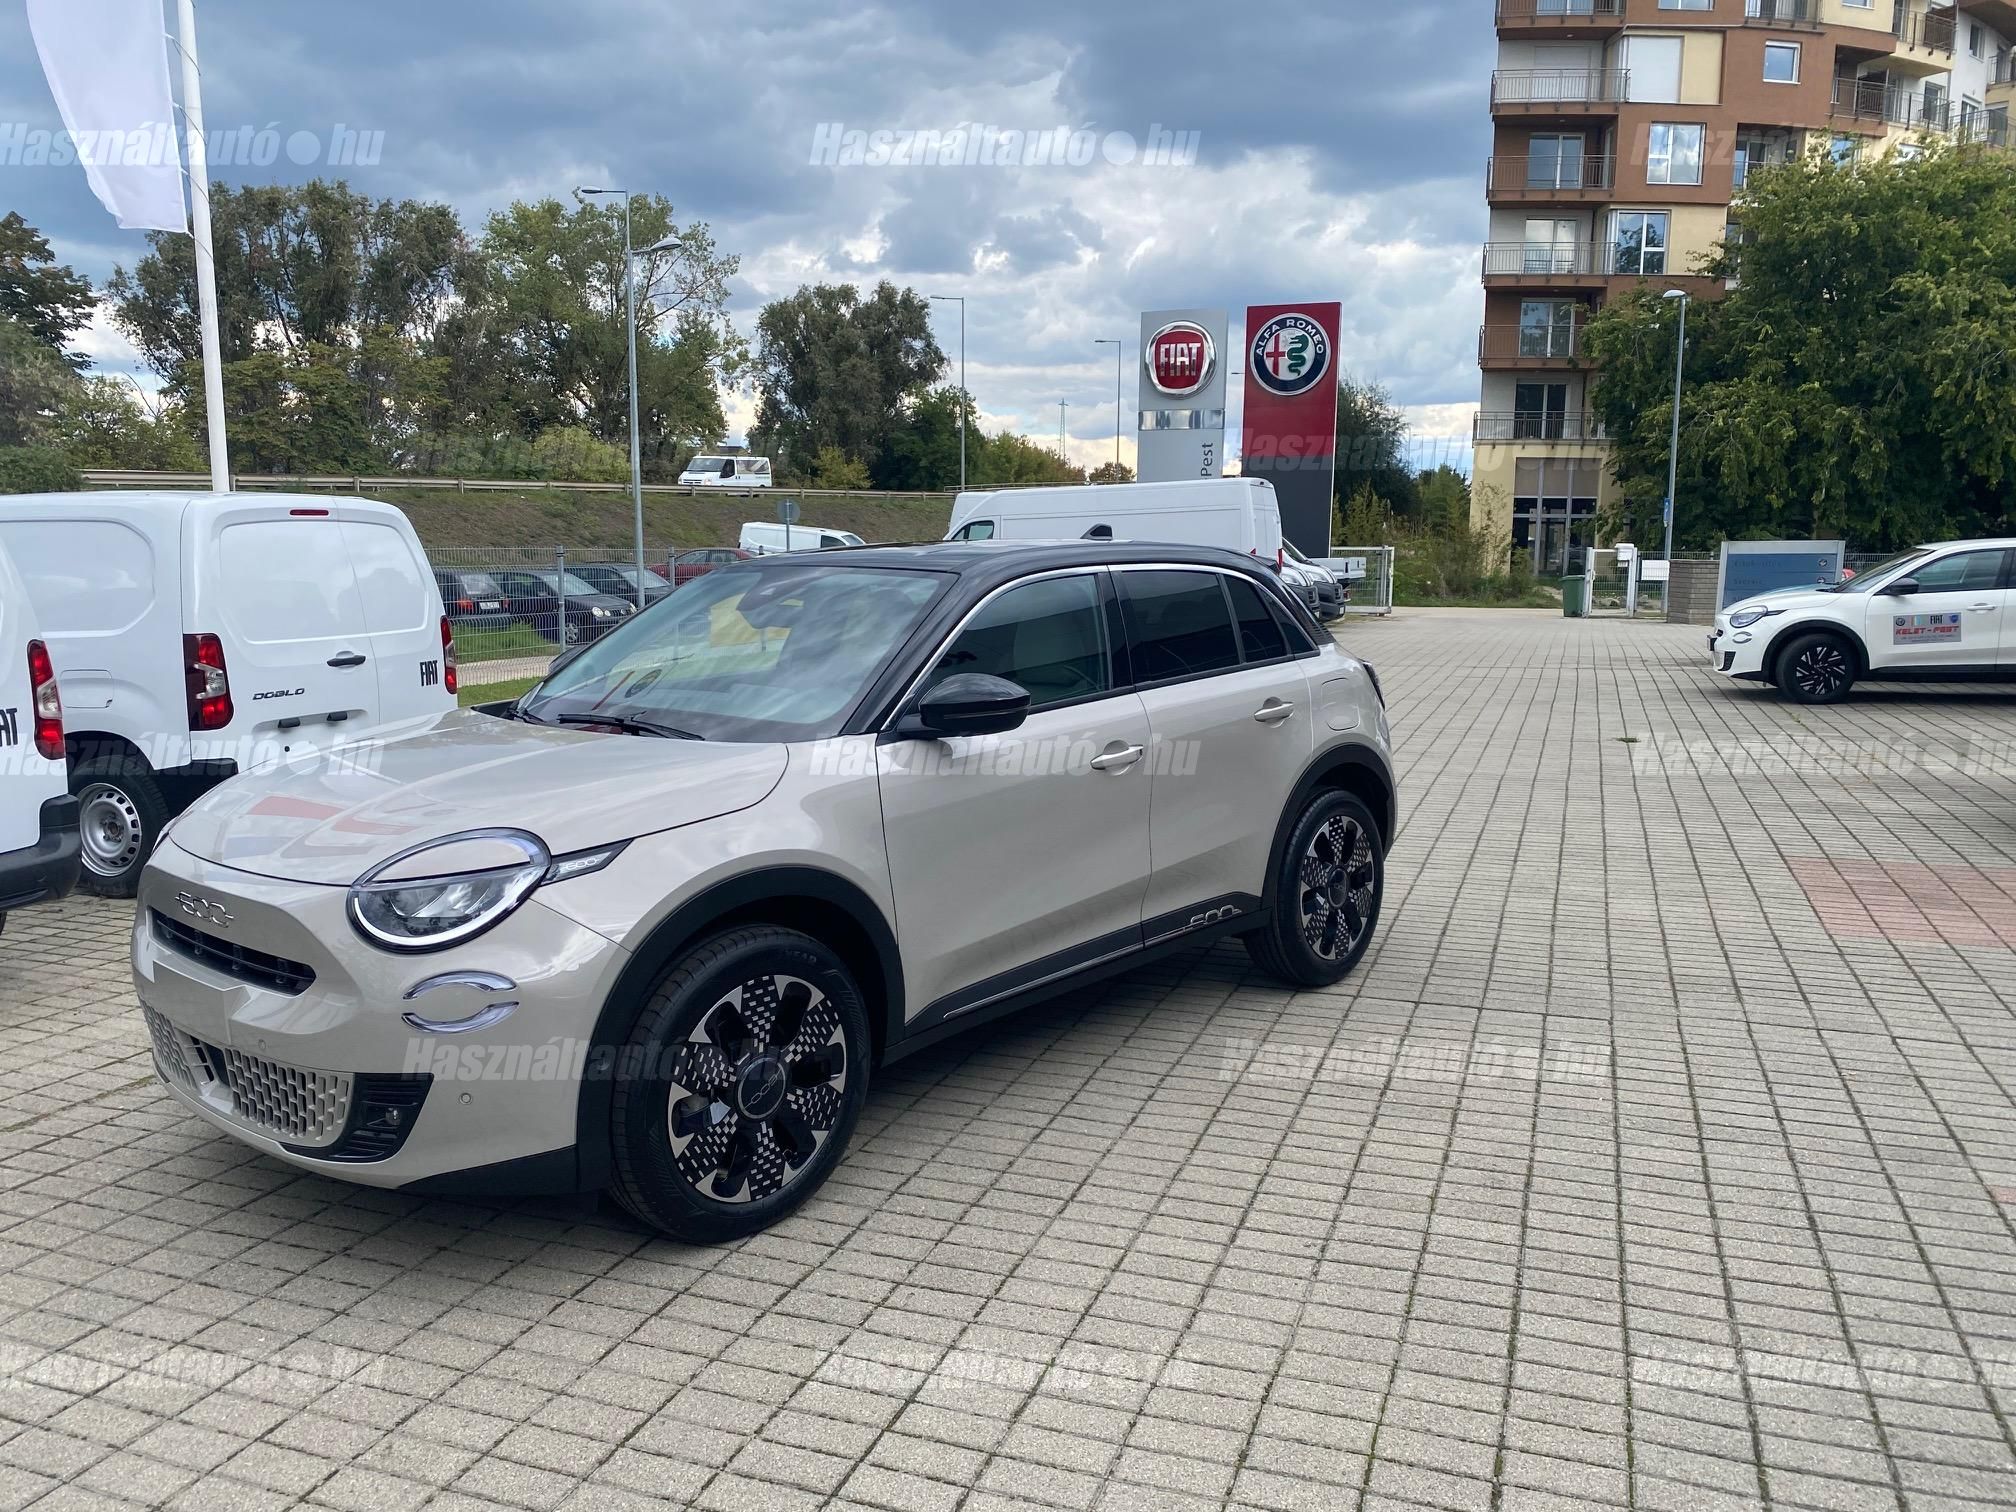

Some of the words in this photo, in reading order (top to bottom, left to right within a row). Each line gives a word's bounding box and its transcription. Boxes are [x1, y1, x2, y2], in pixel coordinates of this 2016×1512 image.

[1255, 324, 1281, 356] ALFA
[1286, 318, 1325, 354] ROMEO
[1160, 342, 1202, 377] FIAT
[419, 660, 438, 687] FIAT
[252, 687, 305, 700] DOBLO
[0, 707, 18, 747] AT
